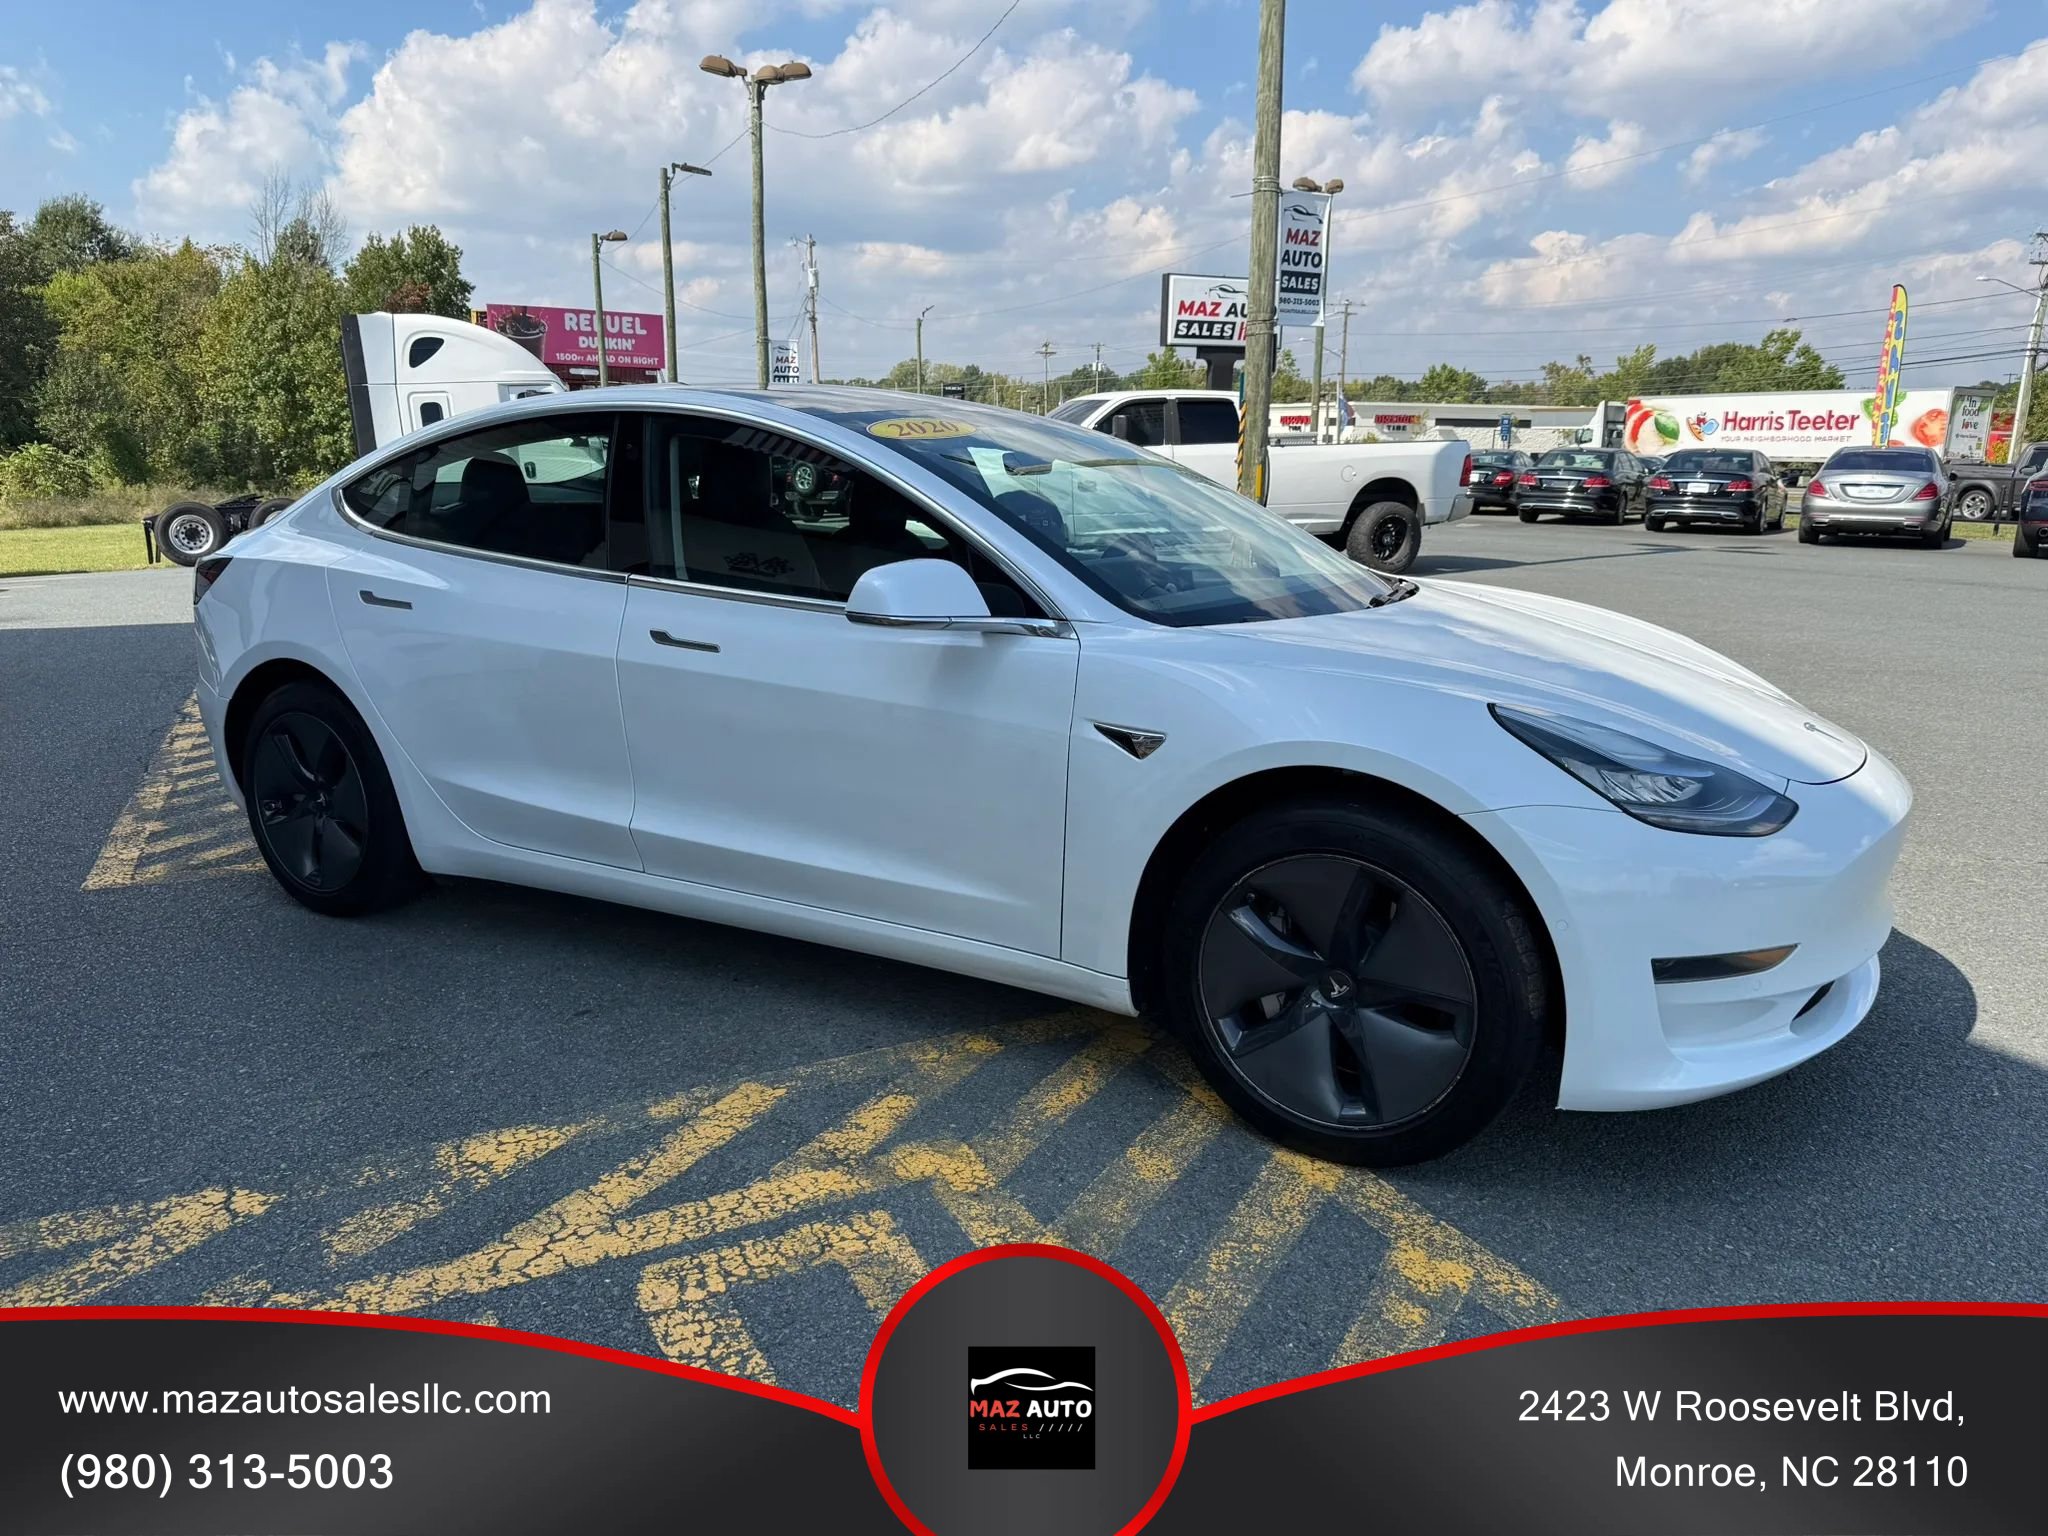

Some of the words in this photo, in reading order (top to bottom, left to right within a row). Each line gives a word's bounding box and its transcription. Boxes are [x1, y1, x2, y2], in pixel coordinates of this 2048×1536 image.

[1285, 228, 1320, 246] MAZ
[1281, 249, 1322, 268] AUTO
[1281, 276, 1319, 290] SALES
[1177, 299, 1222, 317] MAZ
[1177, 322, 1234, 337] SALES
[586, 353, 616, 363] AHAD
[617, 355, 632, 364] ON
[633, 356, 660, 366] RIGHT
[775, 356, 796, 364] MAZ
[773, 366, 800, 374] AUTO
[1721, 410, 1785, 431] Harris
[1786, 409, 1861, 431] Teeter
[888, 421, 960, 437] 2020
